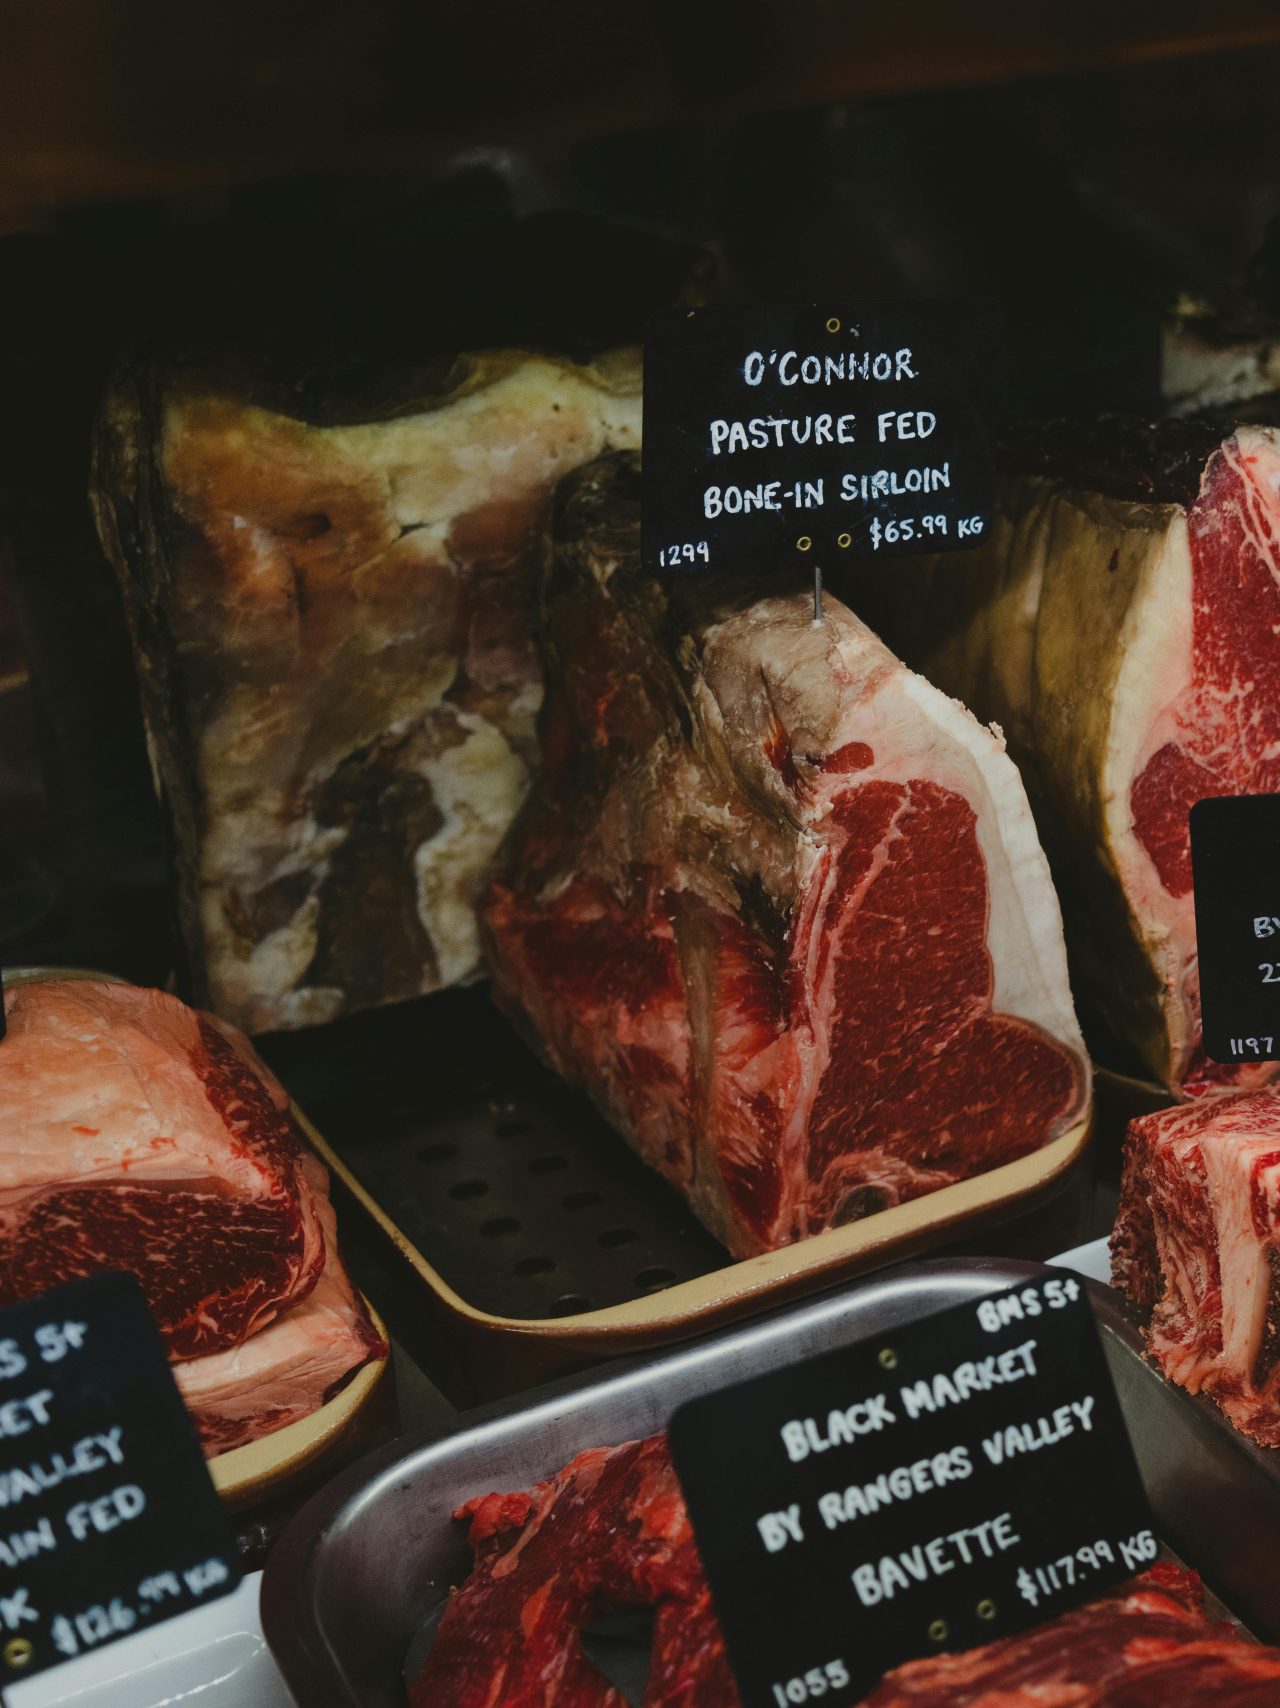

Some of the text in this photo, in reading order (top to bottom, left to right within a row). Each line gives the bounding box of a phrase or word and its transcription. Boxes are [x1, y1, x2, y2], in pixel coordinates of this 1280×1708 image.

[744, 348, 919, 386] O'CONNOR
[710, 411, 936, 454] PASTURE FED
[704, 462, 951, 519] BONE-IN SIRLOIN
[659, 542, 710, 567] 1299
[869, 514, 984, 550] $65.99 KG
[1230, 1036, 1273, 1056] 1197
[976, 1277, 1080, 1333] BMS 5+
[780, 1340, 1038, 1462] BLACK MARKET
[756, 1396, 1095, 1553] BY RANGERS VALLEY
[67, 1483, 146, 1540] FED
[851, 1512, 1021, 1606] BAVETTE
[1016, 1529, 1158, 1606] $117.99 KG
[772, 1658, 850, 1708] 1055
